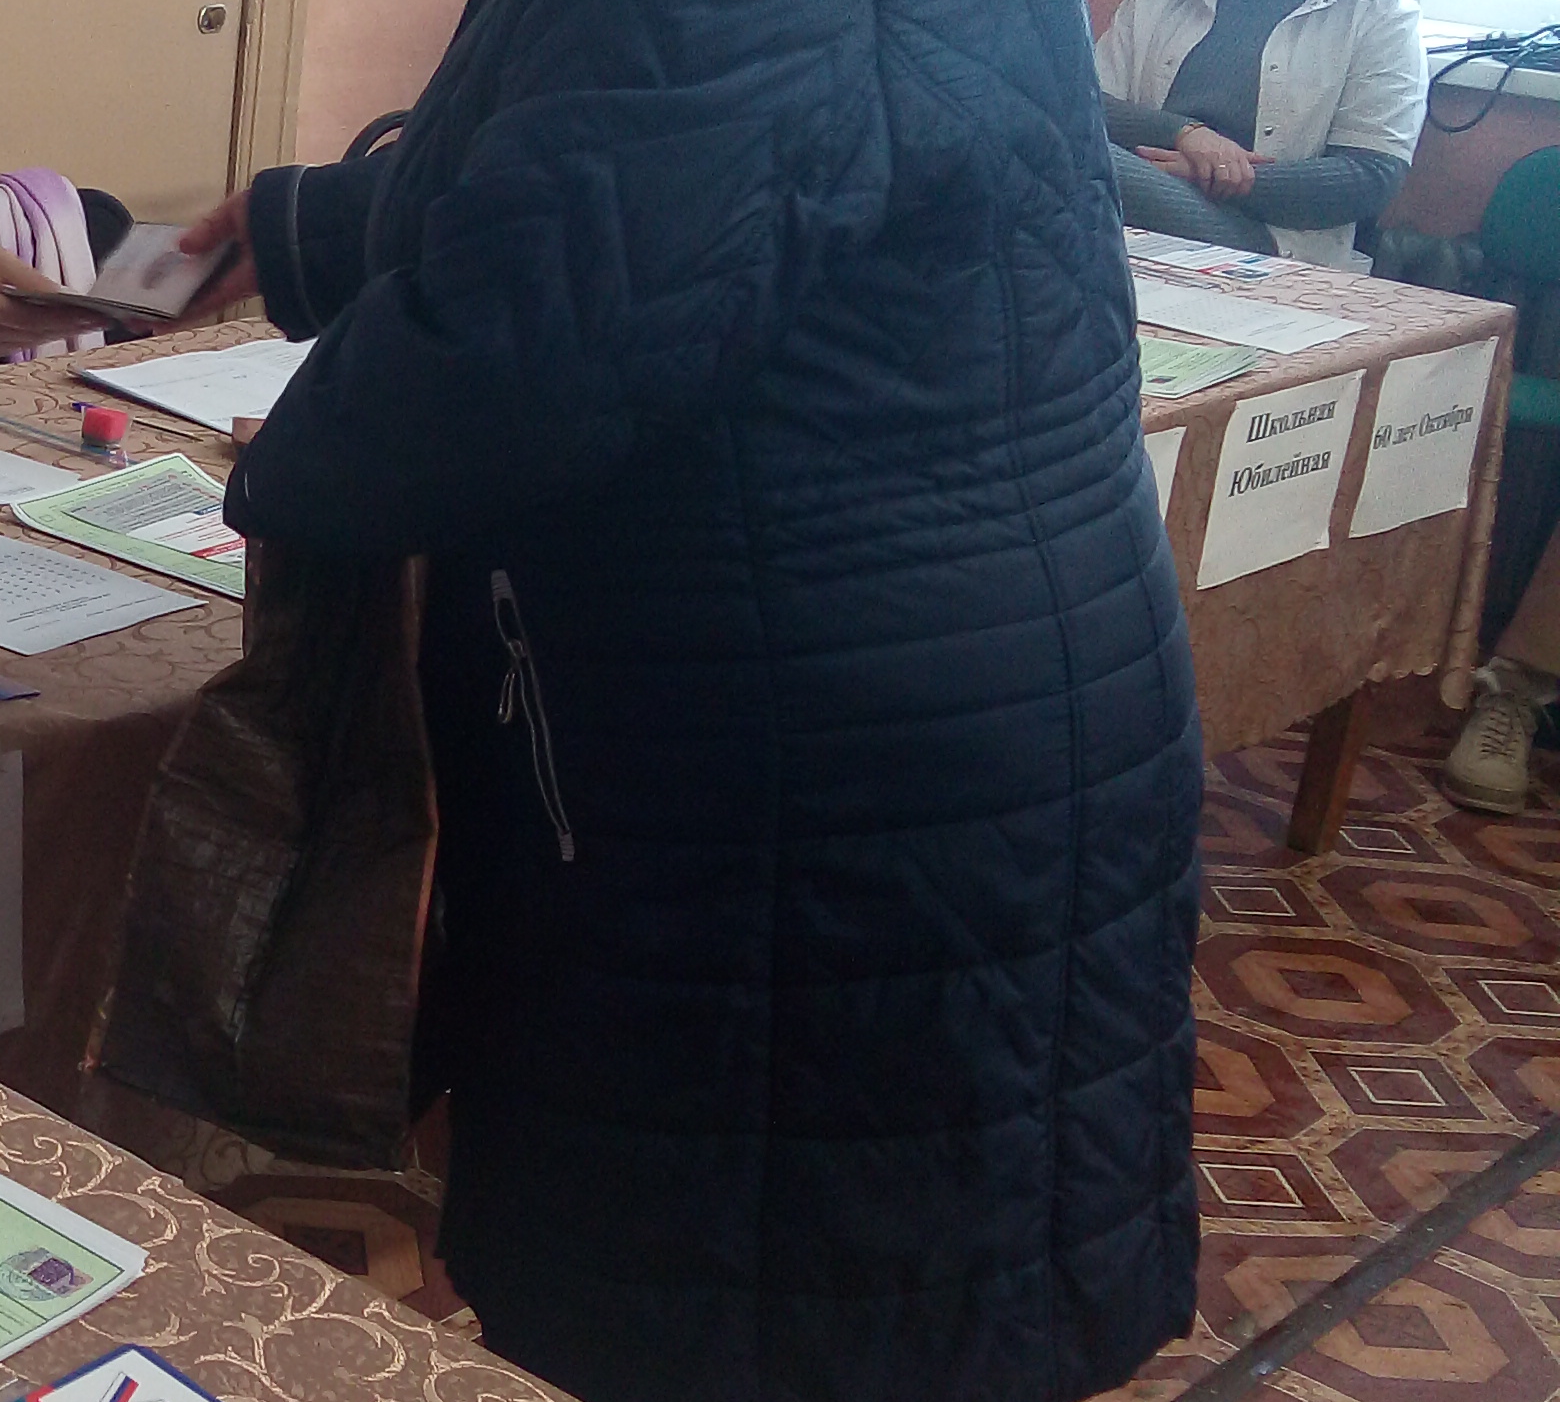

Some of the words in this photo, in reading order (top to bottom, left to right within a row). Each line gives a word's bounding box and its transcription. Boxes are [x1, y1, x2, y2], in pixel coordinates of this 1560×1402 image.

[1246, 400, 1337, 442] Школьная
[1373, 425, 1390, 450] 60
[1391, 423, 1416, 446] лет
[1418, 404, 1473, 439] Октября
[1228, 451, 1331, 498] Юбилейная
